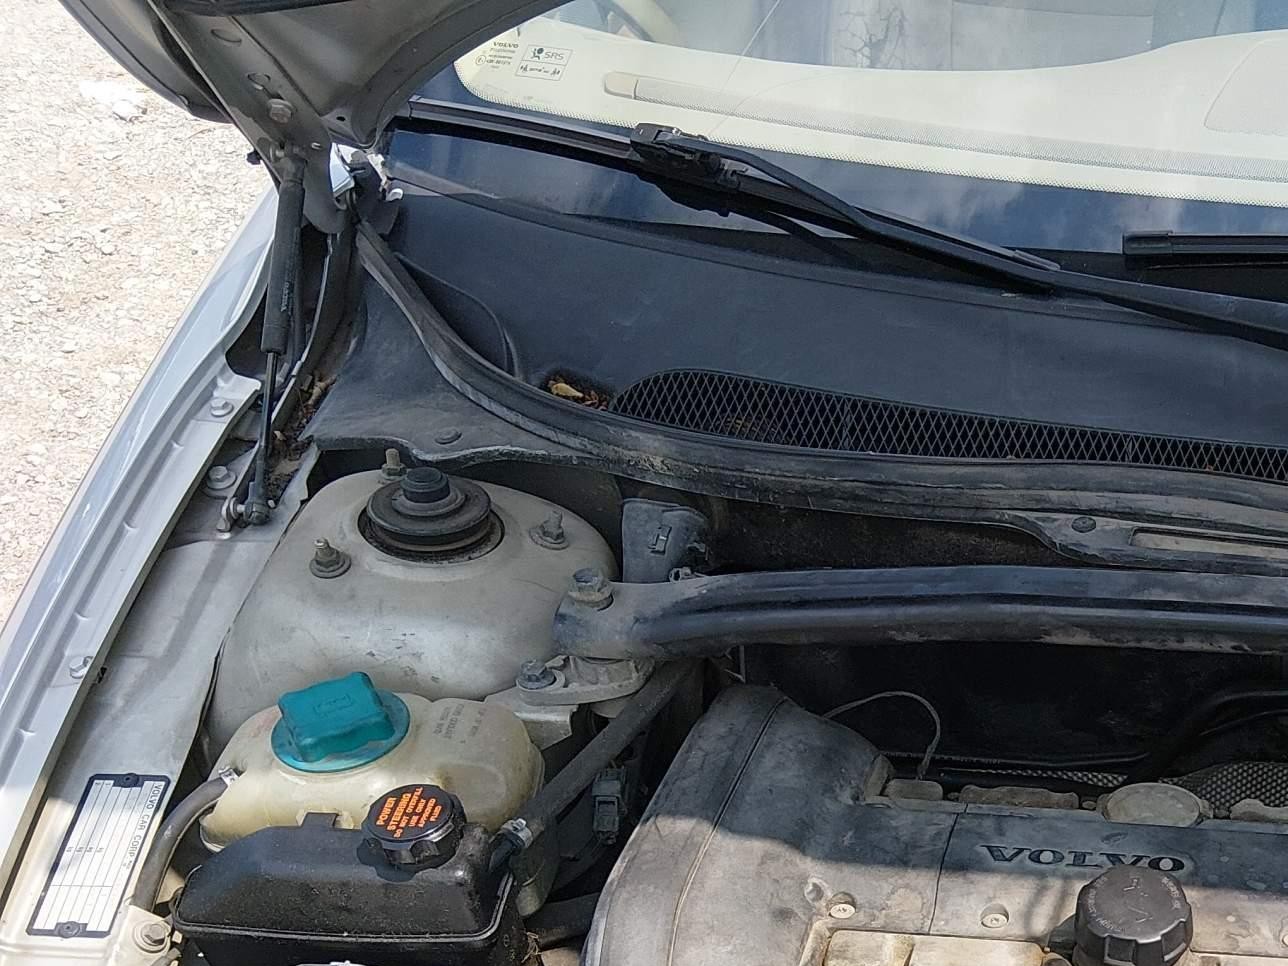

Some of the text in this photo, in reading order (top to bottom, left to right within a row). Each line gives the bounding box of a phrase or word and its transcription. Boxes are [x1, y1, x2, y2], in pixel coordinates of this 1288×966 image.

[544, 51, 565, 60] SRS
[147, 784, 163, 810] VOLVO
[137, 814, 151, 831] CAR
[376, 797, 397, 825] POWER
[387, 793, 412, 830] STEERING
[980, 845, 1185, 871] VOLVO
